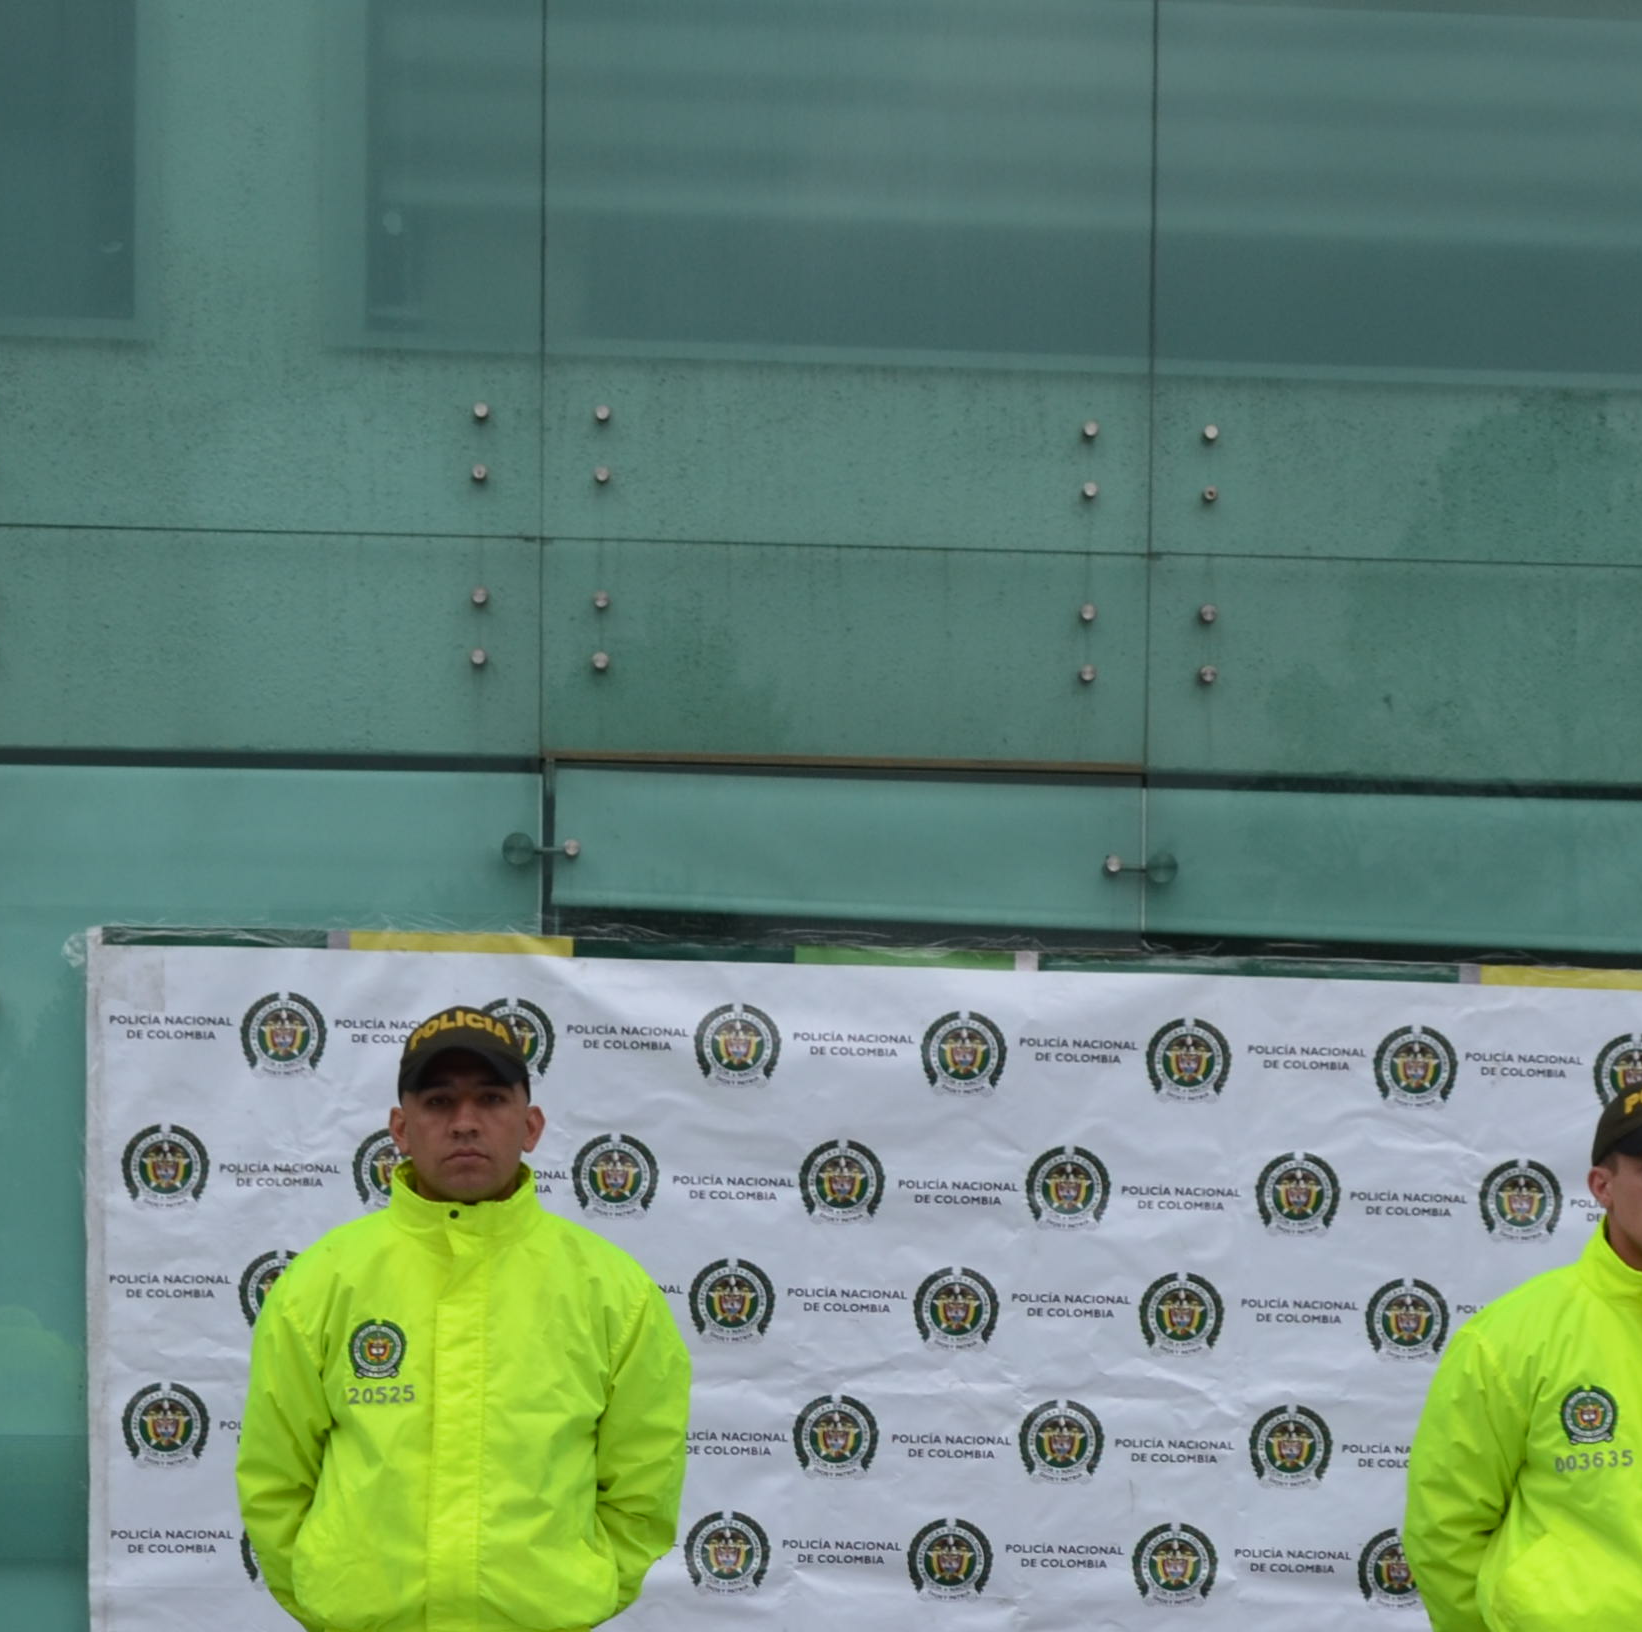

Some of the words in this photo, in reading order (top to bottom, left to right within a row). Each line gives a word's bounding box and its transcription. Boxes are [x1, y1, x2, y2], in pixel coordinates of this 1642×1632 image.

[108, 1013, 162, 1026] POLICÍA
[164, 1015, 233, 1027] NACIONAL
[126, 1029, 144, 1040] DE
[146, 1029, 216, 1041] COLOMBIA
[409, 1009, 512, 1051] POLICIA
[566, 1023, 618, 1036] POLICÍA
[620, 1025, 688, 1038] NACIONAL
[351, 1033, 369, 1044] DE
[793, 1031, 844, 1043] POLICÍA
[846, 1033, 914, 1045] NACIONAL
[1019, 1036, 1070, 1049] POLICÍA
[1071, 1039, 1138, 1051] NACIONAL
[582, 1039, 600, 1050] DE
[602, 1039, 672, 1051] COLOMBIA
[809, 1045, 826, 1056] DE
[829, 1046, 898, 1057] COLOMBIA
[1247, 1044, 1298, 1056] POLICÍA
[1300, 1046, 1366, 1058] NACIONAL
[1034, 1051, 1052, 1062] DE
[1054, 1052, 1121, 1064] COLOMBIA
[1464, 1051, 1515, 1064] POLICÍA
[1517, 1054, 1582, 1066] NACIONAL
[1263, 1059, 1280, 1070] DE
[1282, 1059, 1350, 1071] COLOMBIA
[1480, 1066, 1498, 1077] DE
[1499, 1066, 1567, 1079] COLOMBIA
[218, 1162, 271, 1174] POLICÍA
[273, 1163, 341, 1175] NACIONAL
[533, 1170, 569, 1180] ONAL
[235, 1176, 253, 1188] DE
[255, 1176, 324, 1188] COLOMBIA
[672, 1174, 724, 1186] POLICÍA
[726, 1176, 795, 1188] NACIONAL
[898, 1178, 949, 1190] POLICÍA
[951, 1181, 1019, 1193] NACIONAL
[689, 1189, 706, 1200] DE
[708, 1189, 777, 1201] COLOMBIA
[1120, 1184, 1172, 1197] POLICÍA
[1174, 1186, 1241, 1198] NACIONAL
[1349, 1190, 1400, 1202] POLICÍA
[1402, 1192, 1468, 1205] NACIONAL
[913, 1193, 932, 1205] DE
[933, 1194, 1002, 1206] COLOMBIA
[1137, 1199, 1154, 1210] DE
[1156, 1200, 1225, 1211] COLOMBIA
[1365, 1205, 1383, 1216] DE
[1384, 1205, 1452, 1217] COLOMBIA
[109, 1273, 161, 1285] POLICÍA
[162, 1274, 232, 1285] NACIONAL
[125, 1288, 143, 1299] DE
[145, 1288, 215, 1299] COLOMBIA
[786, 1286, 838, 1299] POLICÍA
[839, 1288, 908, 1300] NACIONAL
[1011, 1292, 1062, 1304] POLICÍA
[1063, 1294, 1132, 1305] NACIONAL
[803, 1301, 821, 1312] DE
[822, 1302, 891, 1313] COLOMBIA
[1240, 1298, 1290, 1309] POLICÍA
[1292, 1299, 1359, 1311] NACIONAL
[1026, 1307, 1044, 1318] DE
[1045, 1307, 1115, 1319] COLOMBIA
[1255, 1312, 1273, 1323] DE
[1274, 1312, 1342, 1325] COLOMBIA
[685, 1429, 718, 1441] LICÍA
[721, 1431, 789, 1443] NACIONAL
[891, 1432, 943, 1445] POLICÍA
[944, 1434, 1012, 1446] NACIONAL
[703, 1445, 772, 1456] COLOMBIA
[1114, 1437, 1166, 1449] POLICÍA
[1167, 1439, 1235, 1451] NACIONAL
[1341, 1443, 1391, 1454] POLICÍA
[907, 1447, 925, 1459] DE
[927, 1448, 995, 1460] COLOMBIA
[1130, 1452, 1148, 1463] DE
[1149, 1452, 1218, 1464] COLOMBIA
[1358, 1458, 1374, 1468] DE
[110, 1527, 163, 1540] POLICÍA
[164, 1529, 234, 1540] NACIONAL
[127, 1543, 145, 1554] DE
[147, 1543, 217, 1554] COLOMBIA
[781, 1537, 832, 1550] POLICÍA
[834, 1540, 902, 1552] NACIONAL
[1005, 1542, 1055, 1555] POLICÍA
[1057, 1544, 1125, 1556] NACIONAL
[797, 1553, 814, 1565] DE
[817, 1553, 885, 1565] COLOMBIA
[1234, 1548, 1284, 1559] POLICÍA
[1285, 1549, 1352, 1561] NACIONAL
[1020, 1557, 1038, 1568] DE
[1039, 1557, 1108, 1569] COLOMBIA
[1249, 1562, 1266, 1574] DE
[1268, 1562, 1335, 1574] COLOMBIA
